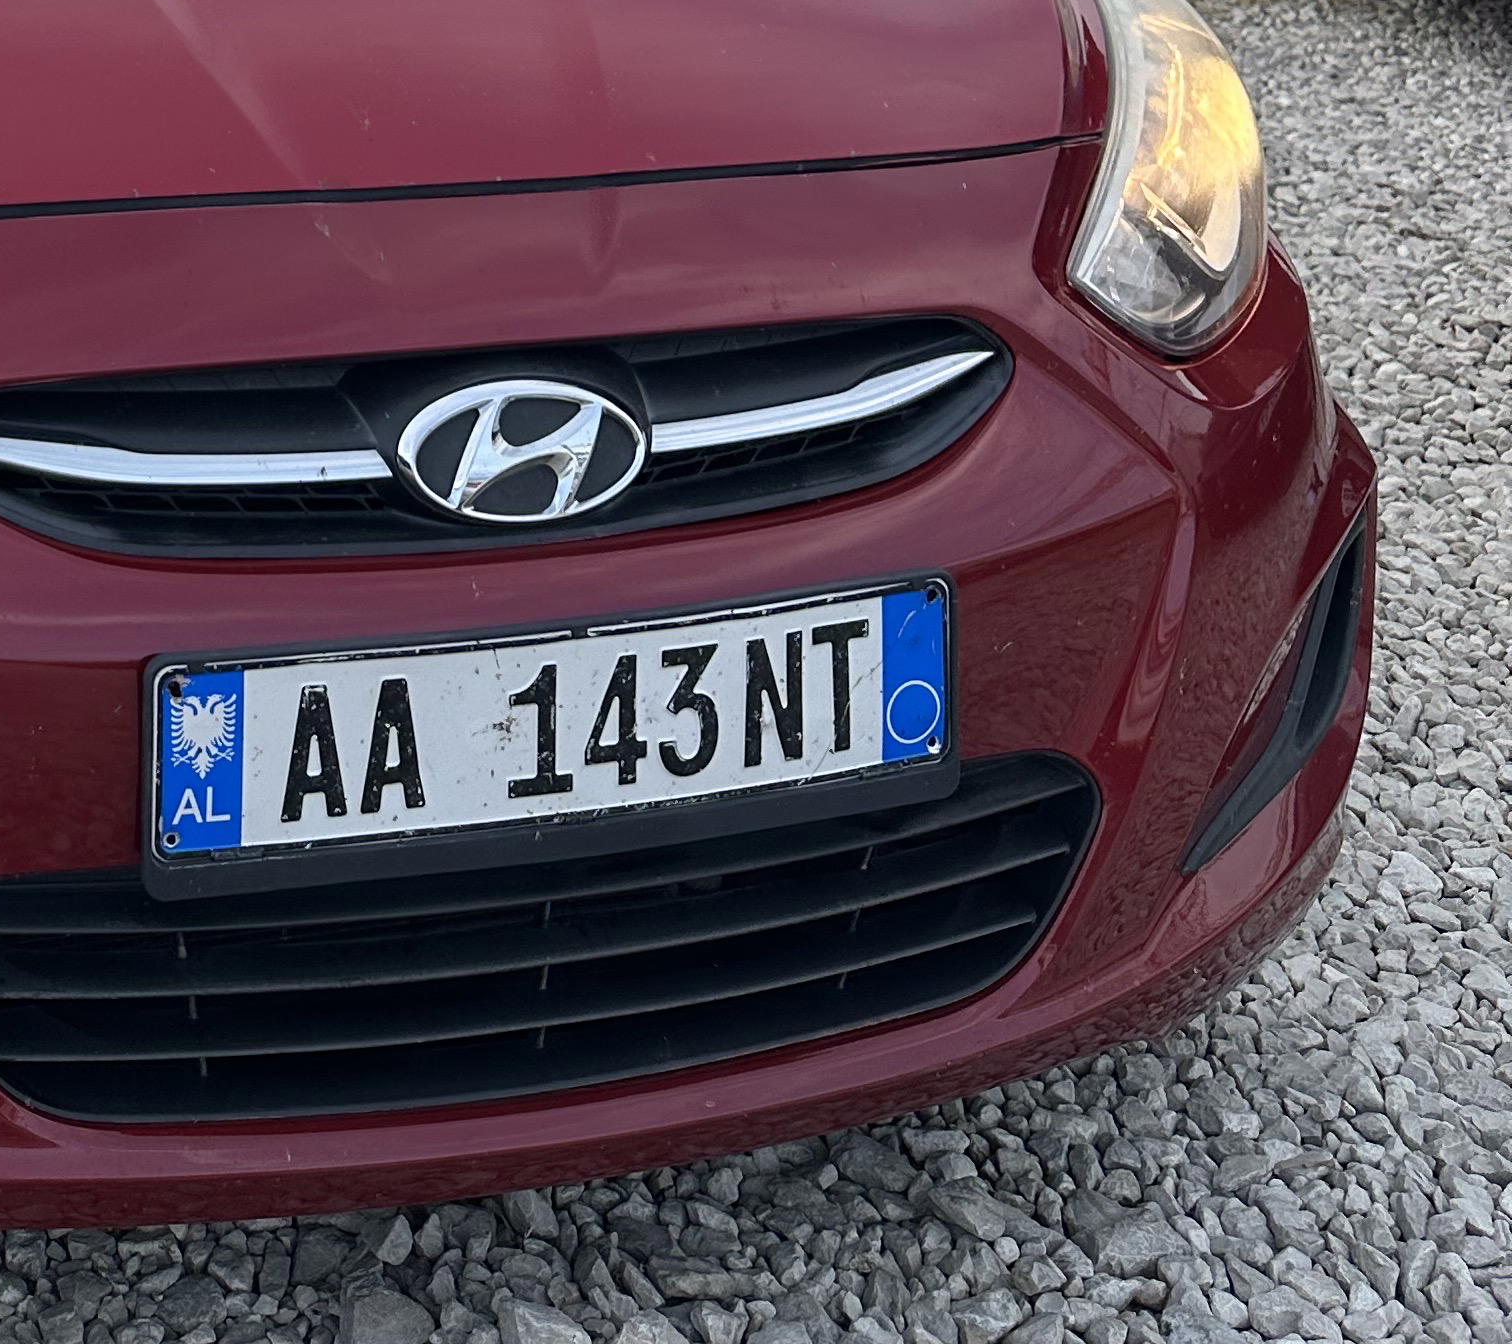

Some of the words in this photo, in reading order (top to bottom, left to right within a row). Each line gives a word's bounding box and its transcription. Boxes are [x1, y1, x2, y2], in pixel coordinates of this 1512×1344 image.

[281, 678, 425, 822] AA
[508, 619, 869, 798] 143NT
[171, 785, 231, 825] AL
